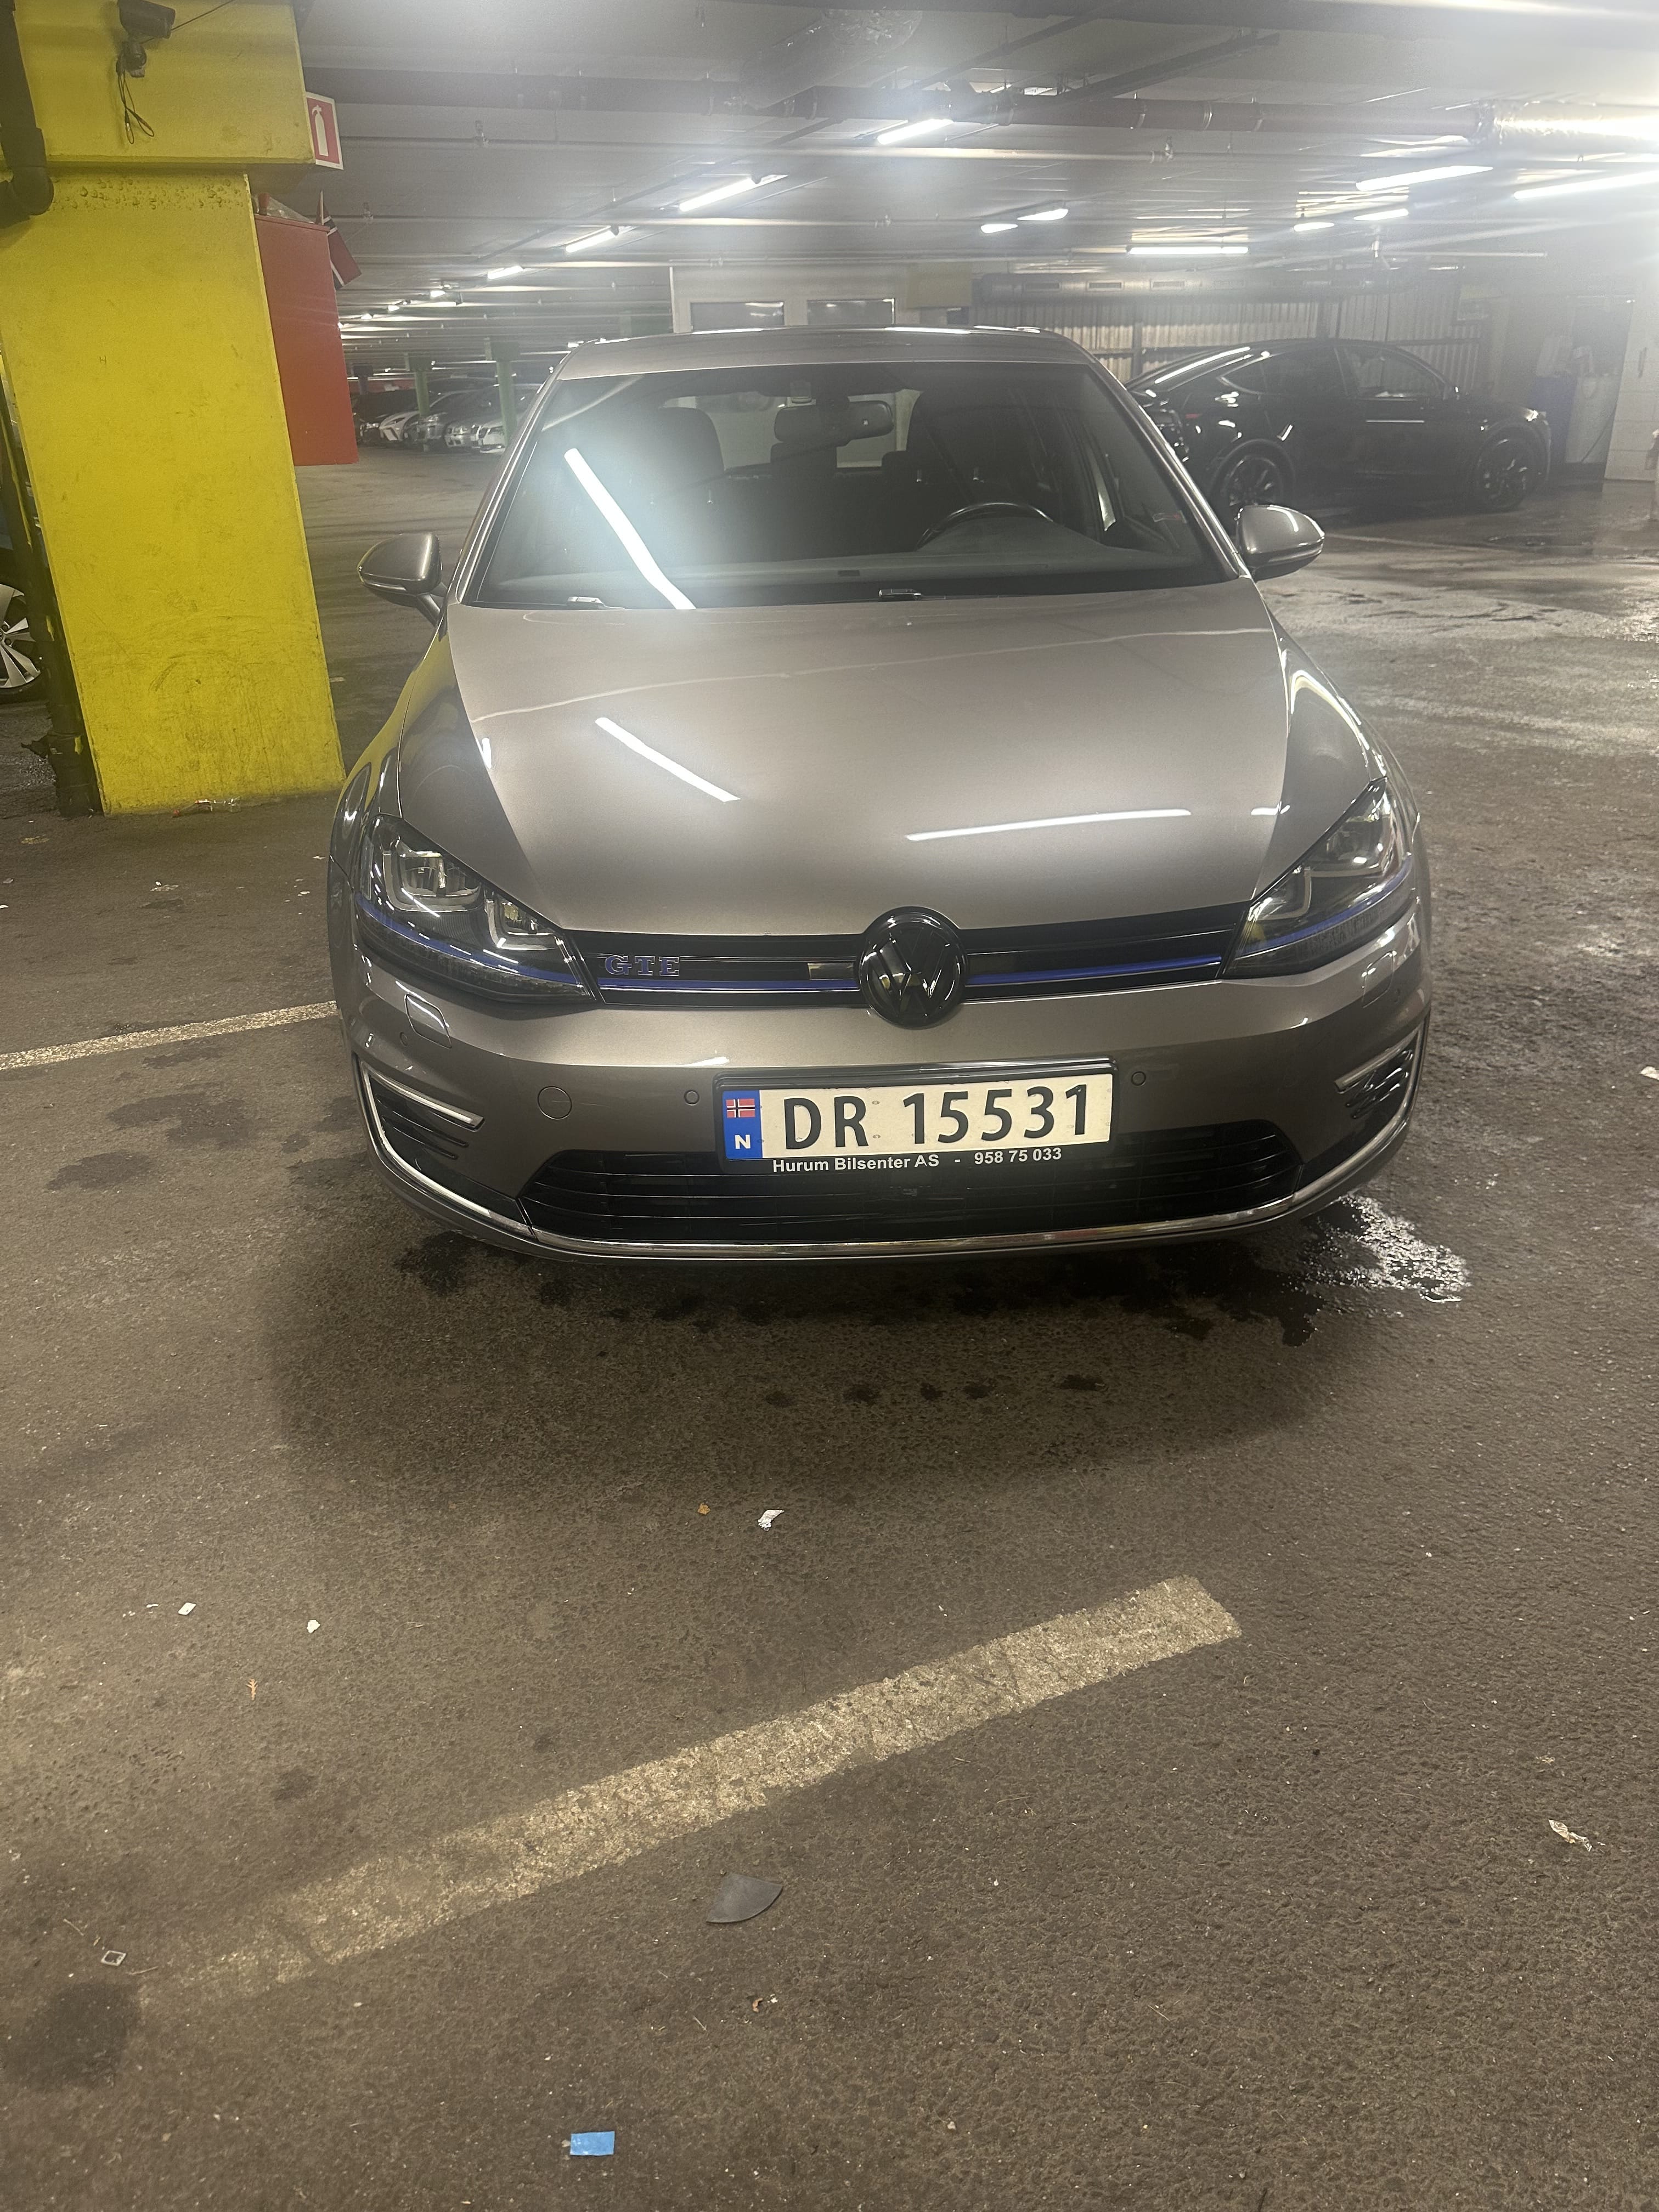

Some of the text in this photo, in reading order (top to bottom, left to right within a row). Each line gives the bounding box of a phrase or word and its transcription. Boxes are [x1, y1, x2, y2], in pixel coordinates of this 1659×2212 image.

[604, 955, 680, 977] GTE
[783, 1084, 1087, 1150] DR 15531
[734, 1134, 752, 1150] N
[772, 1160, 829, 1172] Hurum
[834, 1156, 911, 1170] Bilsenter
[914, 1154, 940, 1167] AS
[974, 1151, 1003, 1165] 958
[1008, 1149, 1028, 1163] 75
[1032, 1147, 1062, 1161] 033
